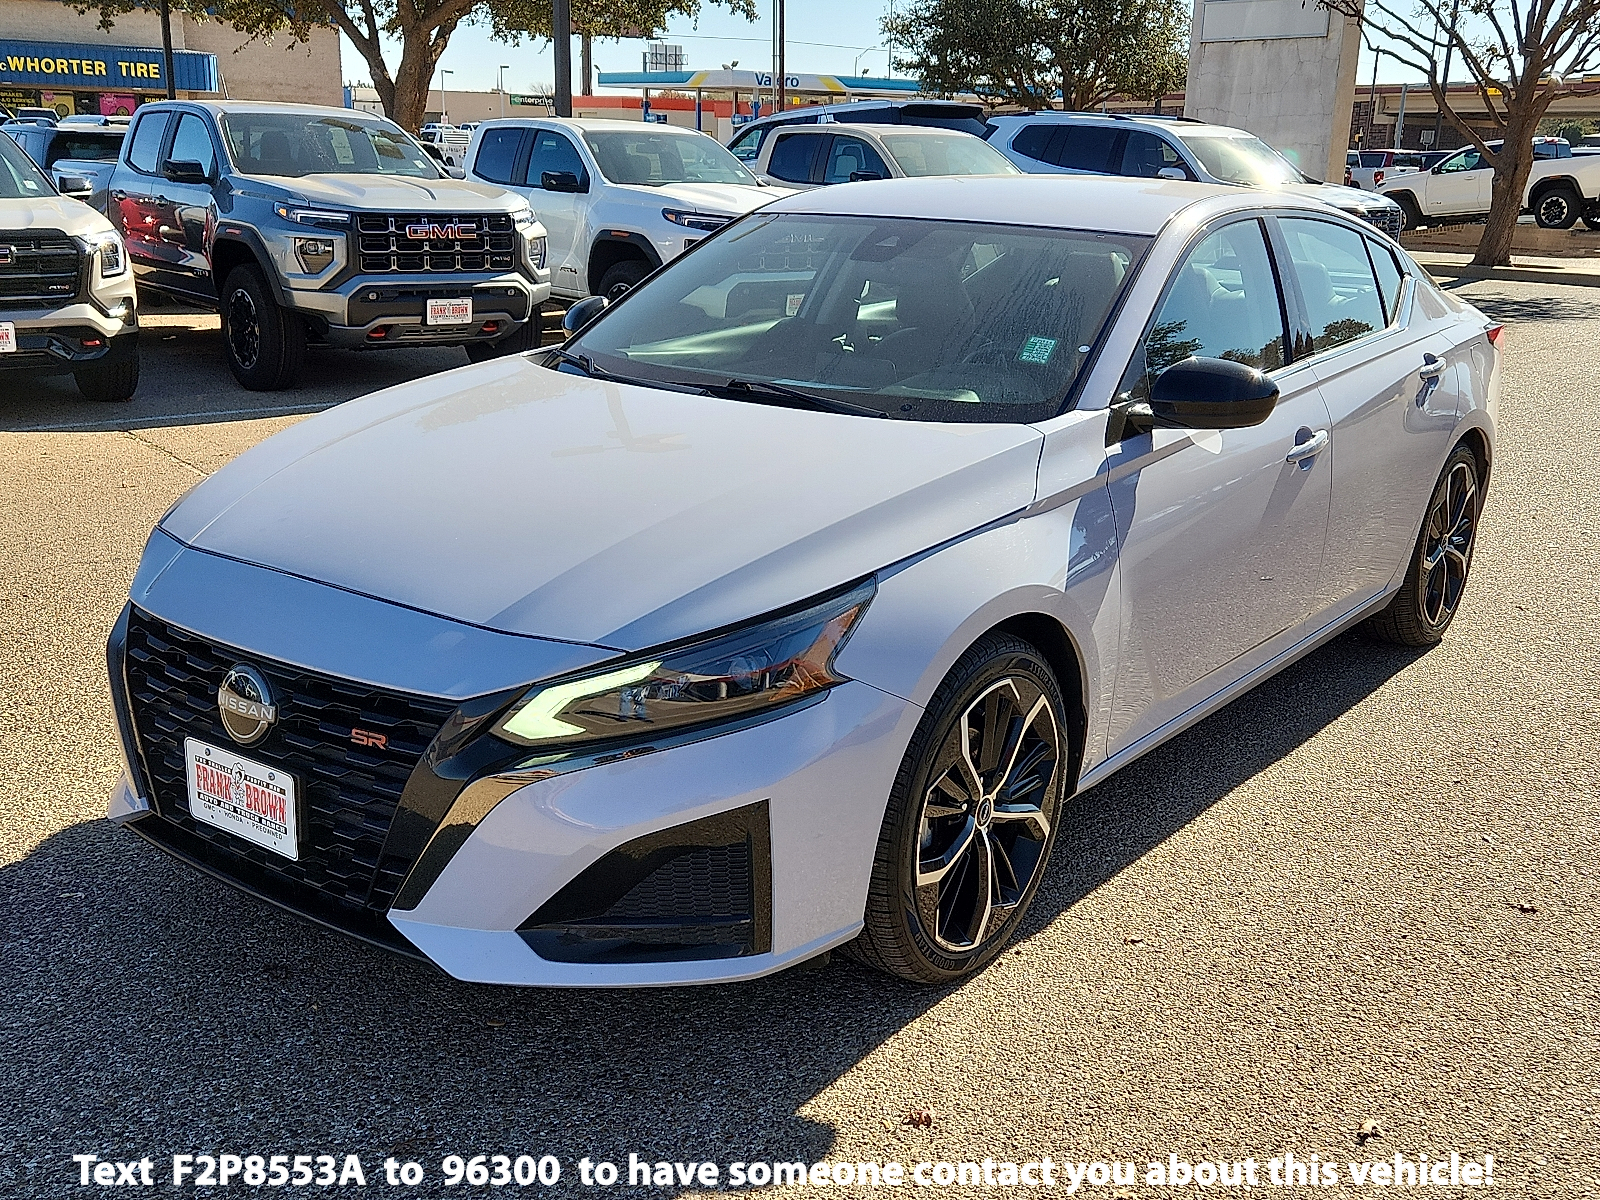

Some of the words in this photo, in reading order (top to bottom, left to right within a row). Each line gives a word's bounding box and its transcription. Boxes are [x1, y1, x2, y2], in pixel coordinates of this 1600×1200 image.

[118, 61, 161, 79] TIRE
[406, 223, 477, 239] GMC
[1028, 662, 1061, 706] ASSURANCE
[219, 692, 273, 720] NISSAN
[351, 727, 387, 750] SR
[195, 763, 233, 802] FRANK
[244, 782, 288, 825] BROWN
[199, 793, 219, 806] AUTO
[220, 801, 235, 812] AND
[235, 807, 260, 823] TRUCK
[261, 817, 286, 834] RANCH
[203, 803, 216, 812] GMC
[224, 810, 244, 824] HONDA
[252, 822, 283, 840] PREOWNED
[914, 931, 956, 971] GOODYEAR
